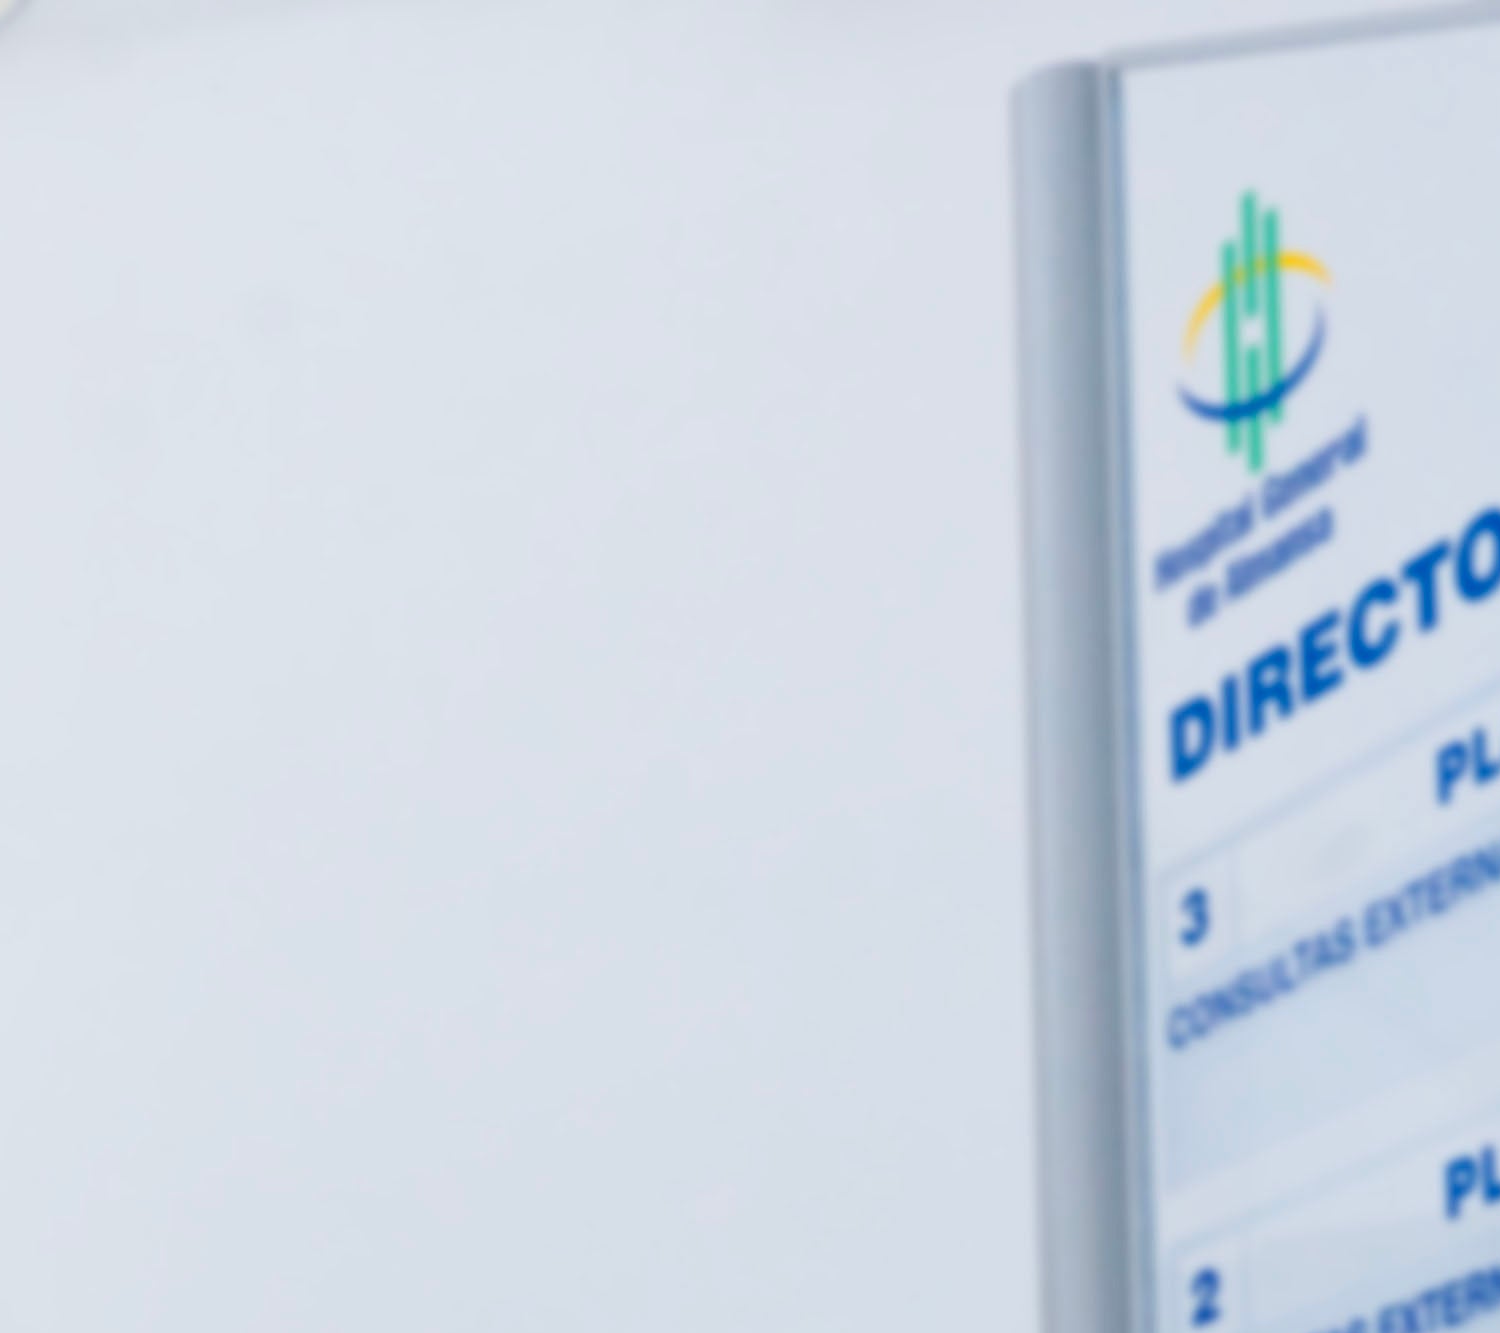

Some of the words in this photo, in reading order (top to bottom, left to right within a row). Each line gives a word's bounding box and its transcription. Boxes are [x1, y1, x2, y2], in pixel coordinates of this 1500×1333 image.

[1178, 885, 1211, 947] 3
[1165, 916, 1355, 1052] CONSULTAS
[1189, 1265, 1221, 1327] 2
